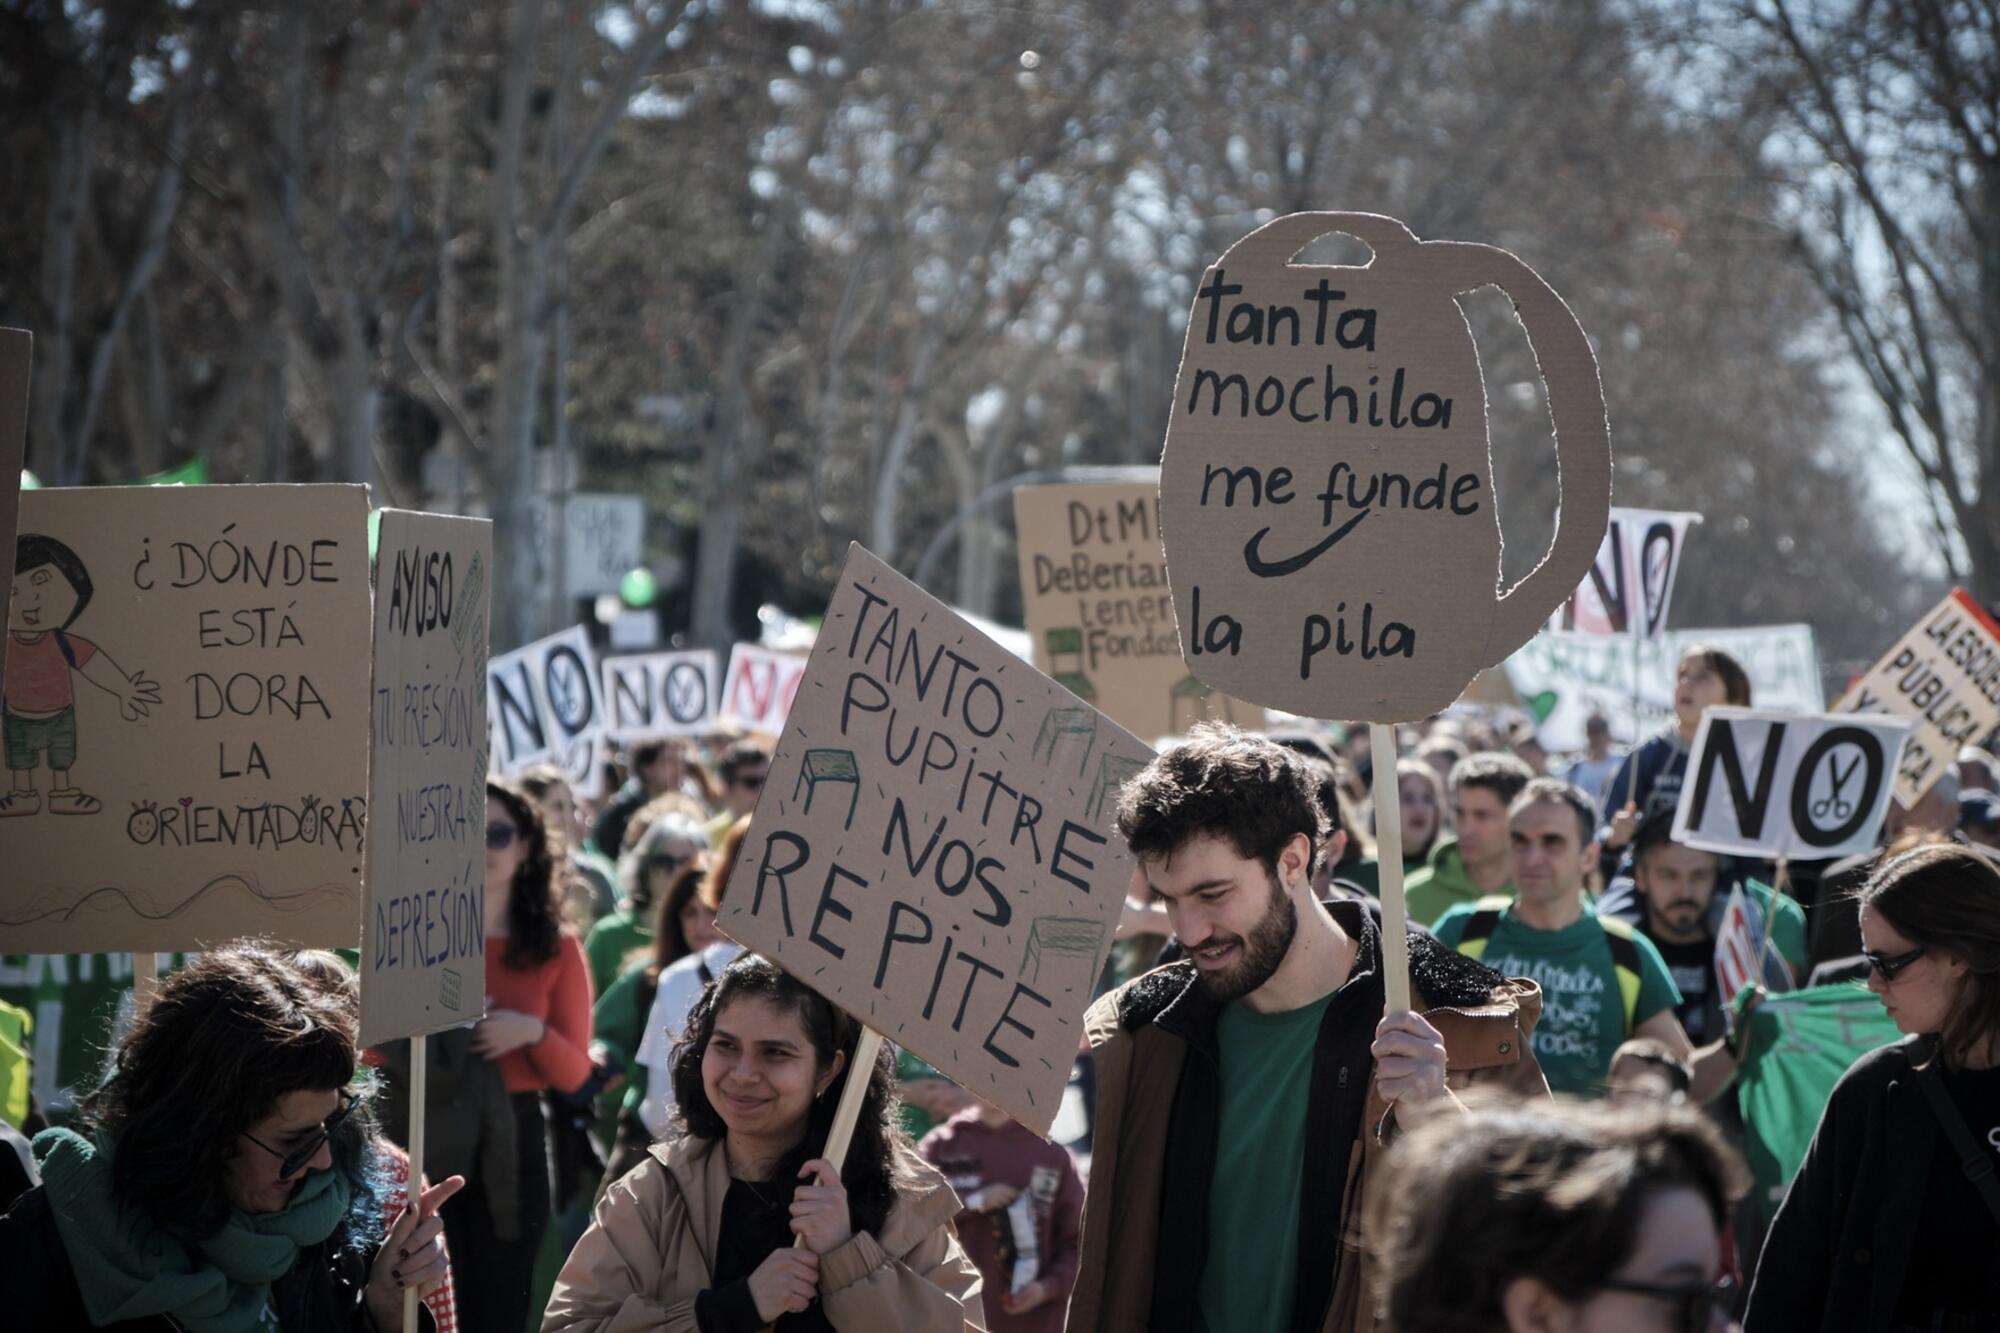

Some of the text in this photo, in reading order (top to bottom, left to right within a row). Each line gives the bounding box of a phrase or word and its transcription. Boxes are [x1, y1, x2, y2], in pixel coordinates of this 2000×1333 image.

[1200, 269, 1377, 352] tanta
[1188, 364, 1453, 431] mochila
[1068, 497, 1161, 546] DtM
[1200, 461, 1481, 528] me funde
[198, 603, 305, 649] ESTÁ
[389, 546, 453, 638] AYUSO
[852, 581, 1005, 739] TANTO
[1189, 585, 1417, 681] la pila
[1947, 627, 2000, 705] ESCUEL
[185, 672, 332, 721] DORA
[378, 687, 395, 747] TU
[490, 644, 593, 763] NO
[614, 661, 708, 729] NO
[730, 653, 806, 722] N
[1881, 645, 1980, 749] PÚBLICA
[219, 740, 272, 781] LA
[1684, 718, 1885, 848] NO
[398, 783, 467, 844] NUESTRA
[882, 797, 1013, 928] NOS
